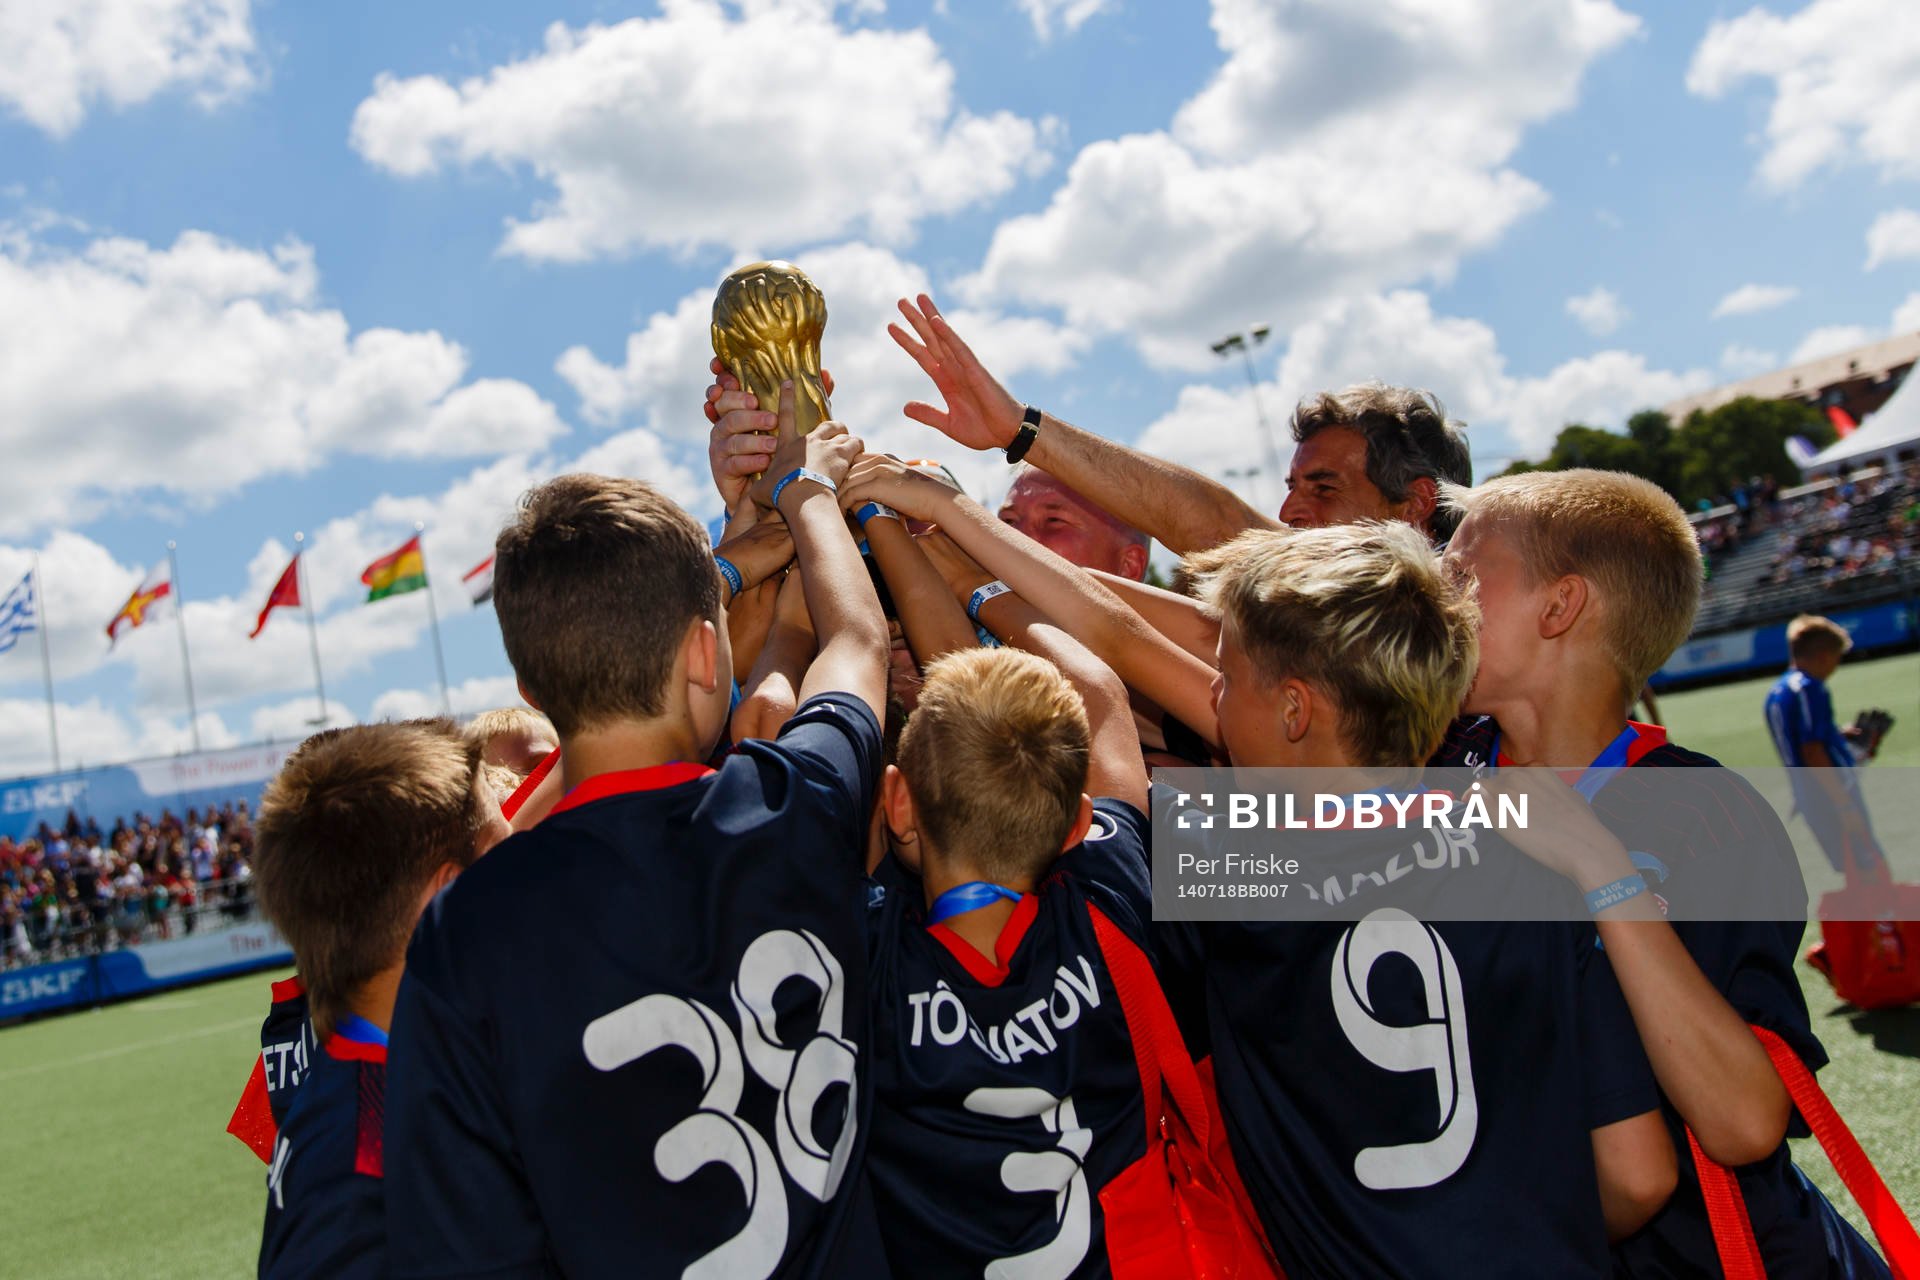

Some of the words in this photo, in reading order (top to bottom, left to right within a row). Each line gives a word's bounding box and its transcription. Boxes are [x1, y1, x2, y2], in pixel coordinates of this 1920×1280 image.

[1, 966, 86, 1005] SKF
[582, 929, 859, 1280] 38
[1331, 907, 1479, 1191] 9
[962, 1087, 1093, 1280] 3
